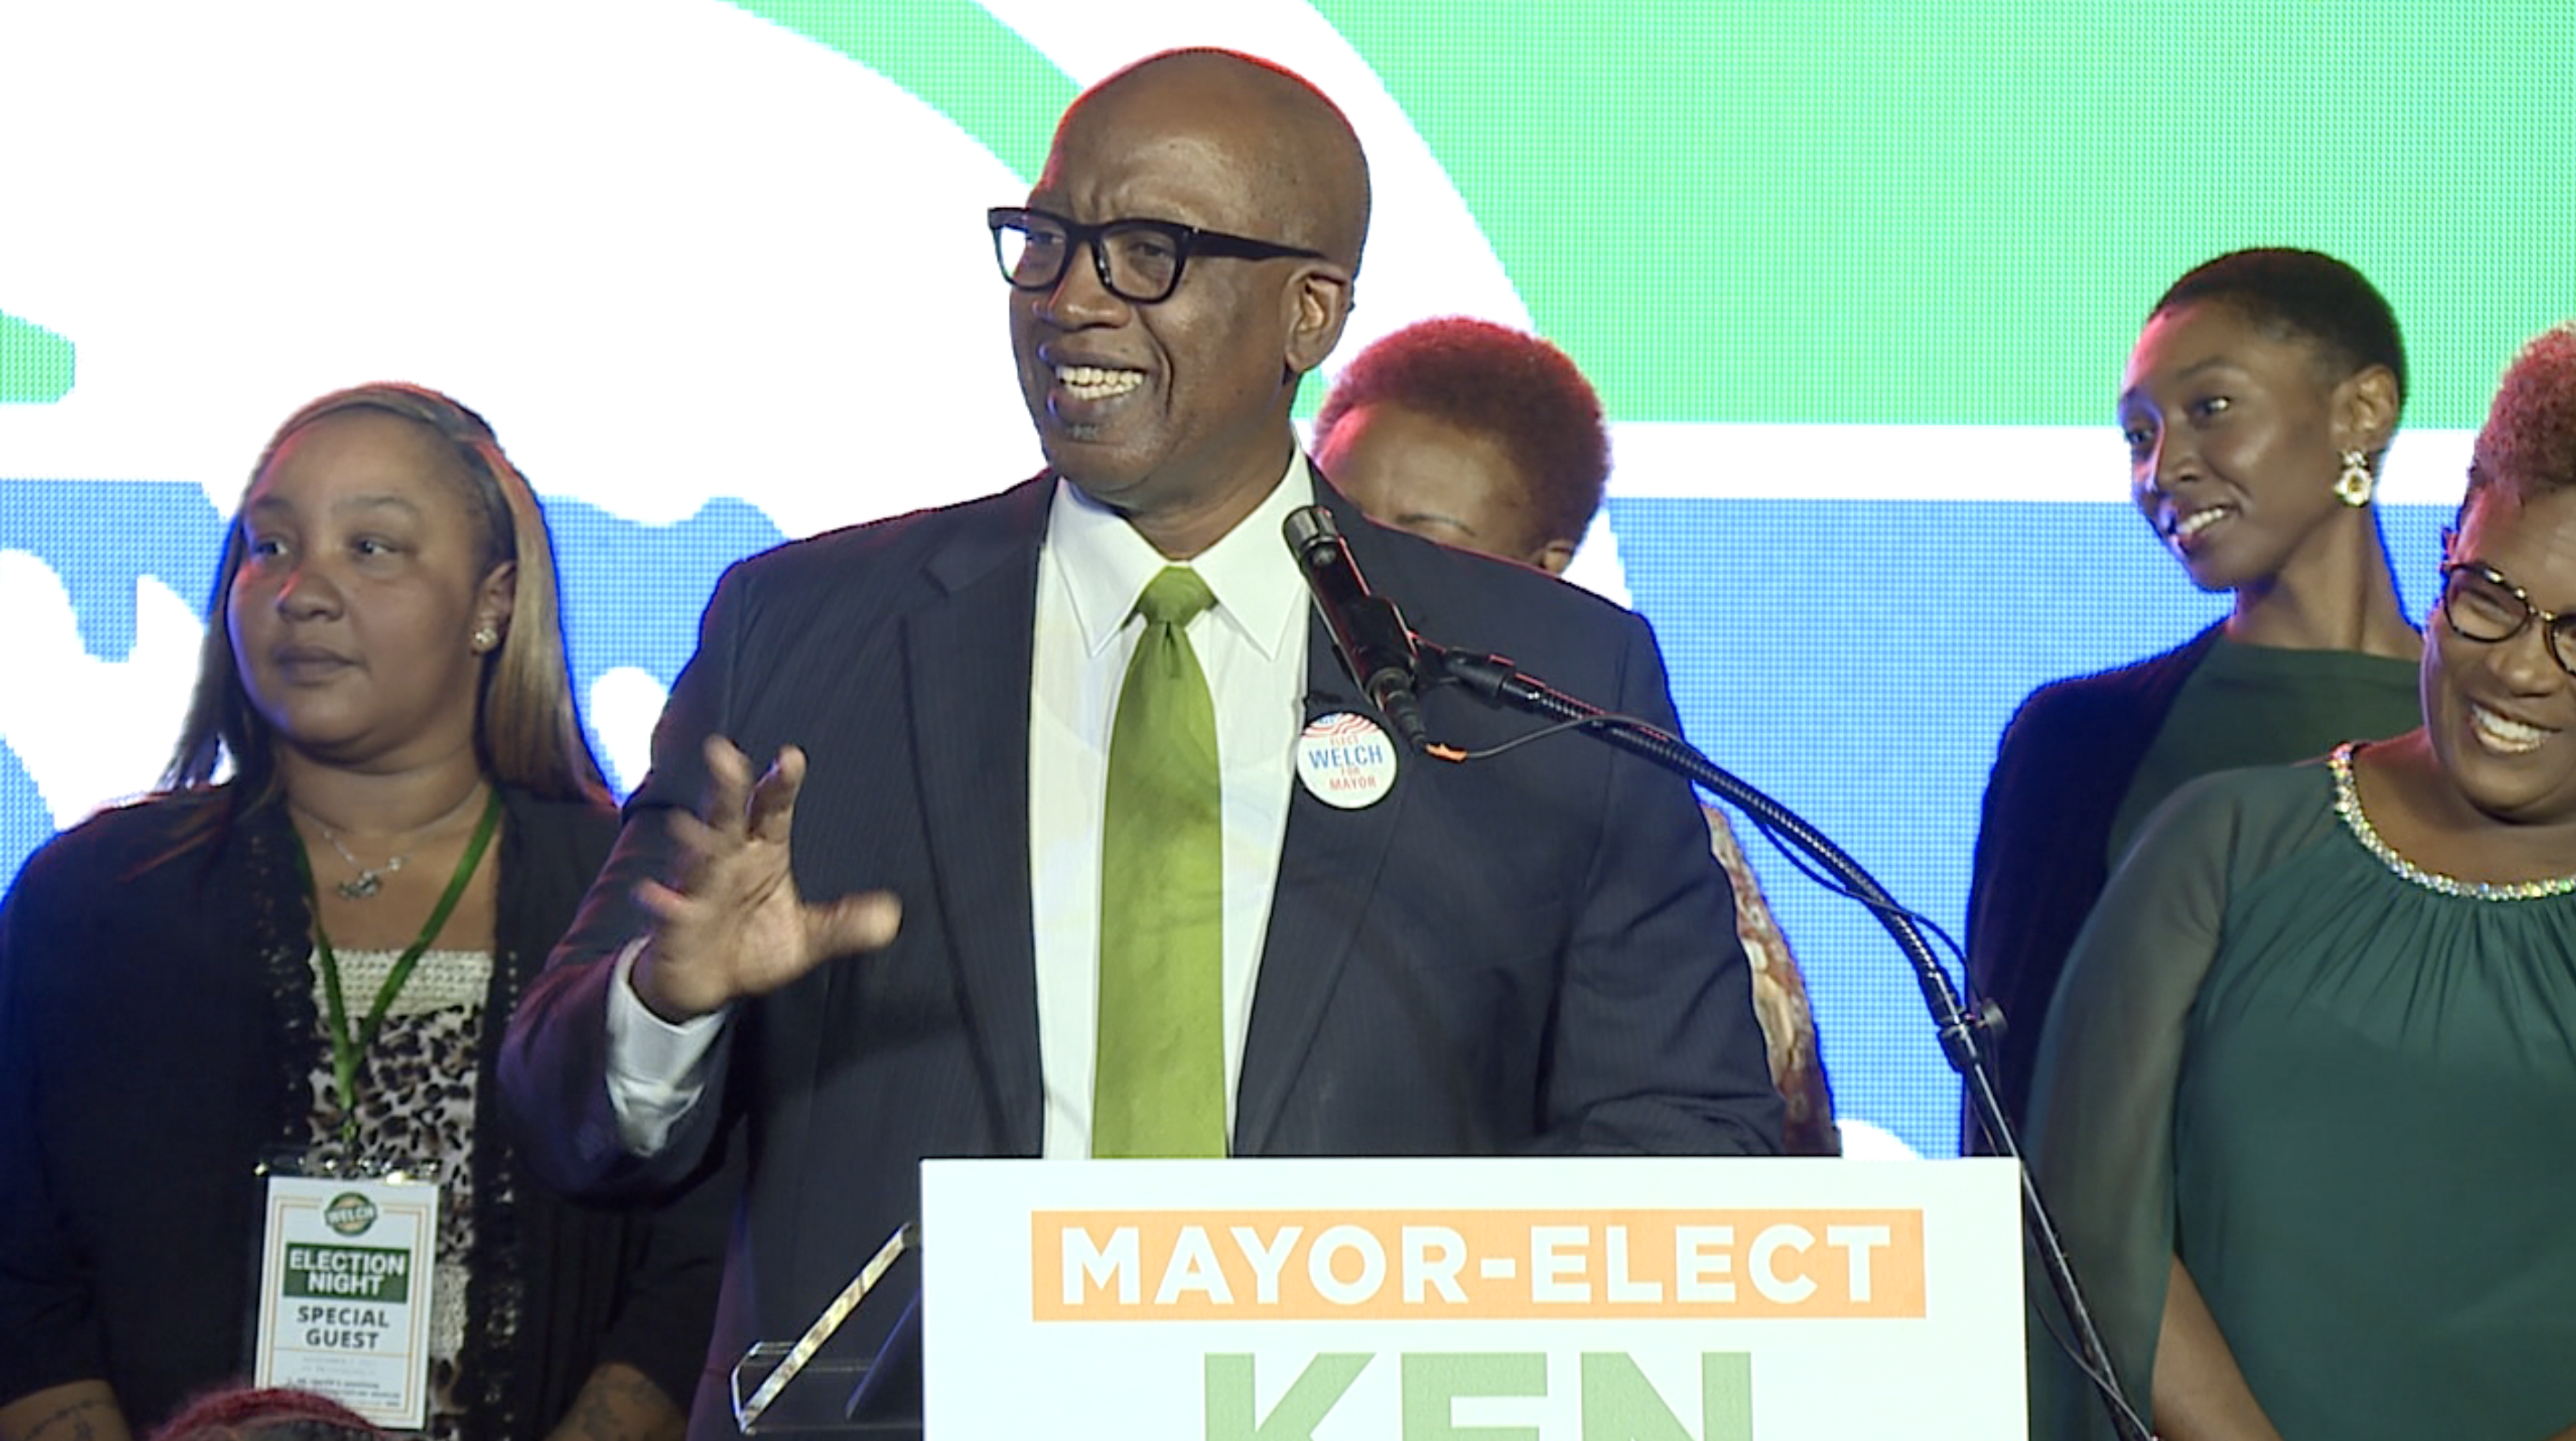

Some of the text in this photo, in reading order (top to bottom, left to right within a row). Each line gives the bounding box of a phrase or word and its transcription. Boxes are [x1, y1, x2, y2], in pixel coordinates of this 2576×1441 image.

[1308, 744, 1383, 769] WELCH
[1330, 775, 1376, 789] MAYOR
[290, 1250, 404, 1275] ELECTION
[1061, 1224, 1891, 1305] MAYOR-ELECT
[308, 1271, 384, 1296] NIGHT
[297, 1306, 389, 1327] SPECIAL
[306, 1329, 379, 1348] GUEST
